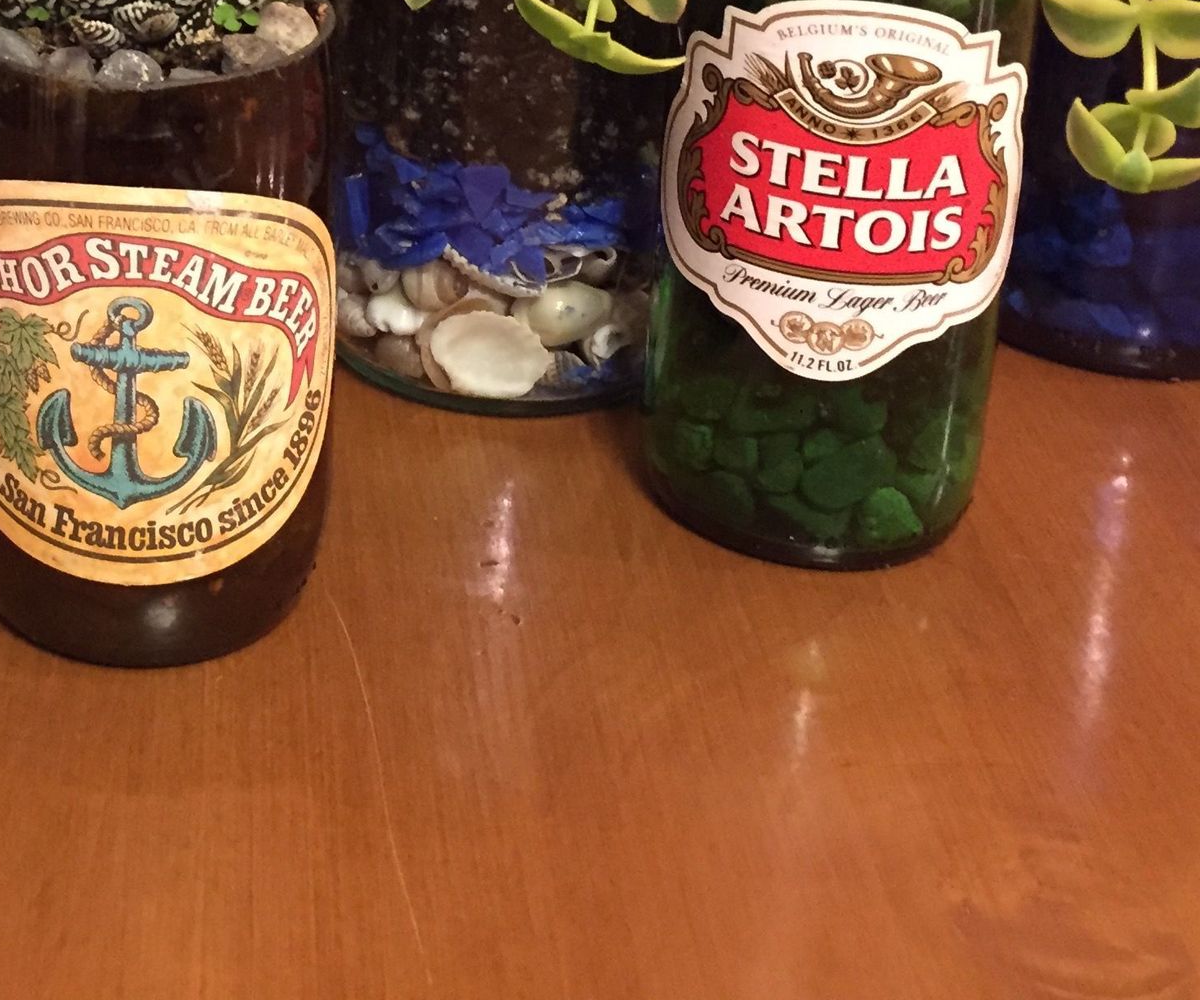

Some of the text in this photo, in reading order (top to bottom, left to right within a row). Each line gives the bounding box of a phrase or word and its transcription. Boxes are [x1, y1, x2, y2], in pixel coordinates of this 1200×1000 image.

[776, 23, 950, 56] BELGIUM'S ORIGINAL
[785, 98, 837, 134] ANNO
[729, 131, 968, 201] STELLA
[68, 212, 93, 229] SAN
[719, 183, 964, 255] ARTOIS
[83, 236, 249, 315] STEAM
[243, 275, 318, 359] BEER
[722, 263, 948, 317] Premium Lager Beer
[790, 351, 815, 370] 11.2
[0, 472, 47, 529] San
[51, 503, 213, 552] Francisco
[218, 466, 290, 537] since
[283, 388, 322, 471] 1896
